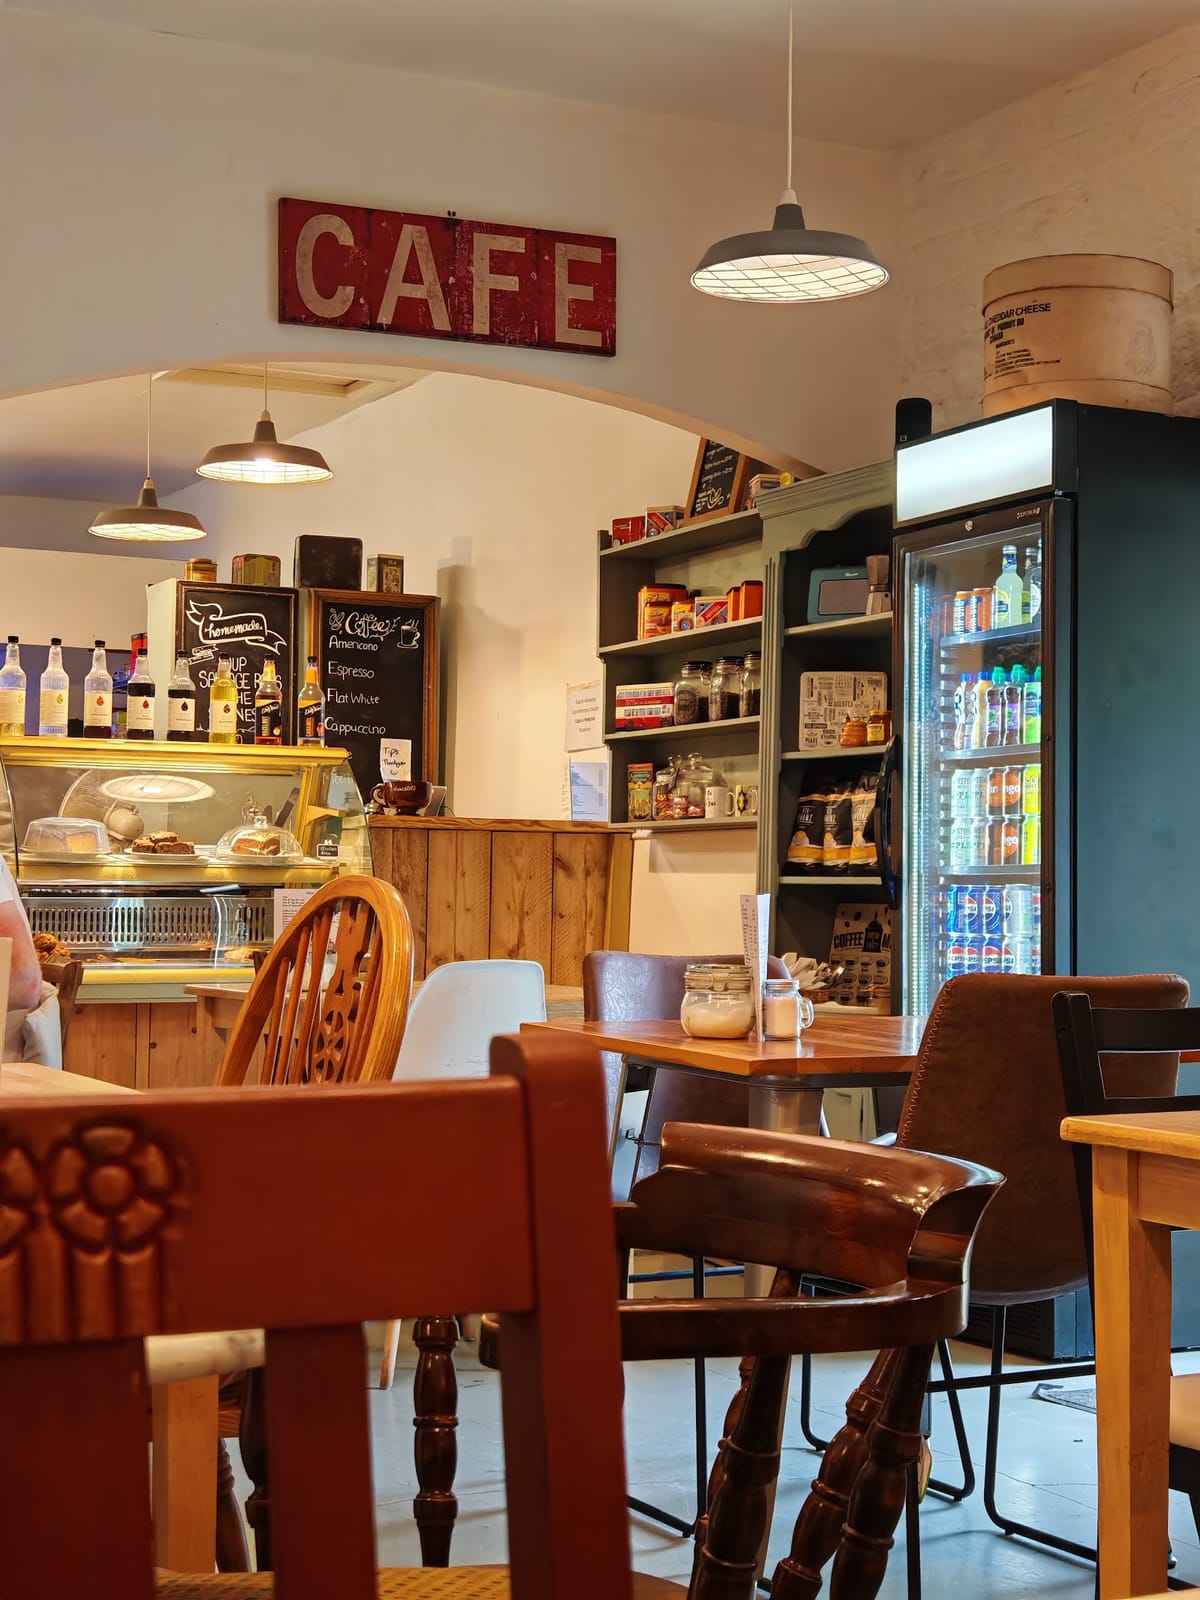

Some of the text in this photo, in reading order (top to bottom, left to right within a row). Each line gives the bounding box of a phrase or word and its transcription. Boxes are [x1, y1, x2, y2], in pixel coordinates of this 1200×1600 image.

[295, 213, 603, 348] CAFE
[1015, 302, 1052, 317] CHEESE
[205, 619, 261, 639] homemade
[345, 611, 391, 639] Coffee
[328, 634, 379, 652] Americano
[327, 660, 375, 681] Espresso
[327, 687, 381, 706] Flat White
[324, 716, 387, 736] Cappuccino
[383, 746, 399, 758] Tips
[833, 931, 864, 949] COFFEE
[984, 957, 1001, 965] EPSI
